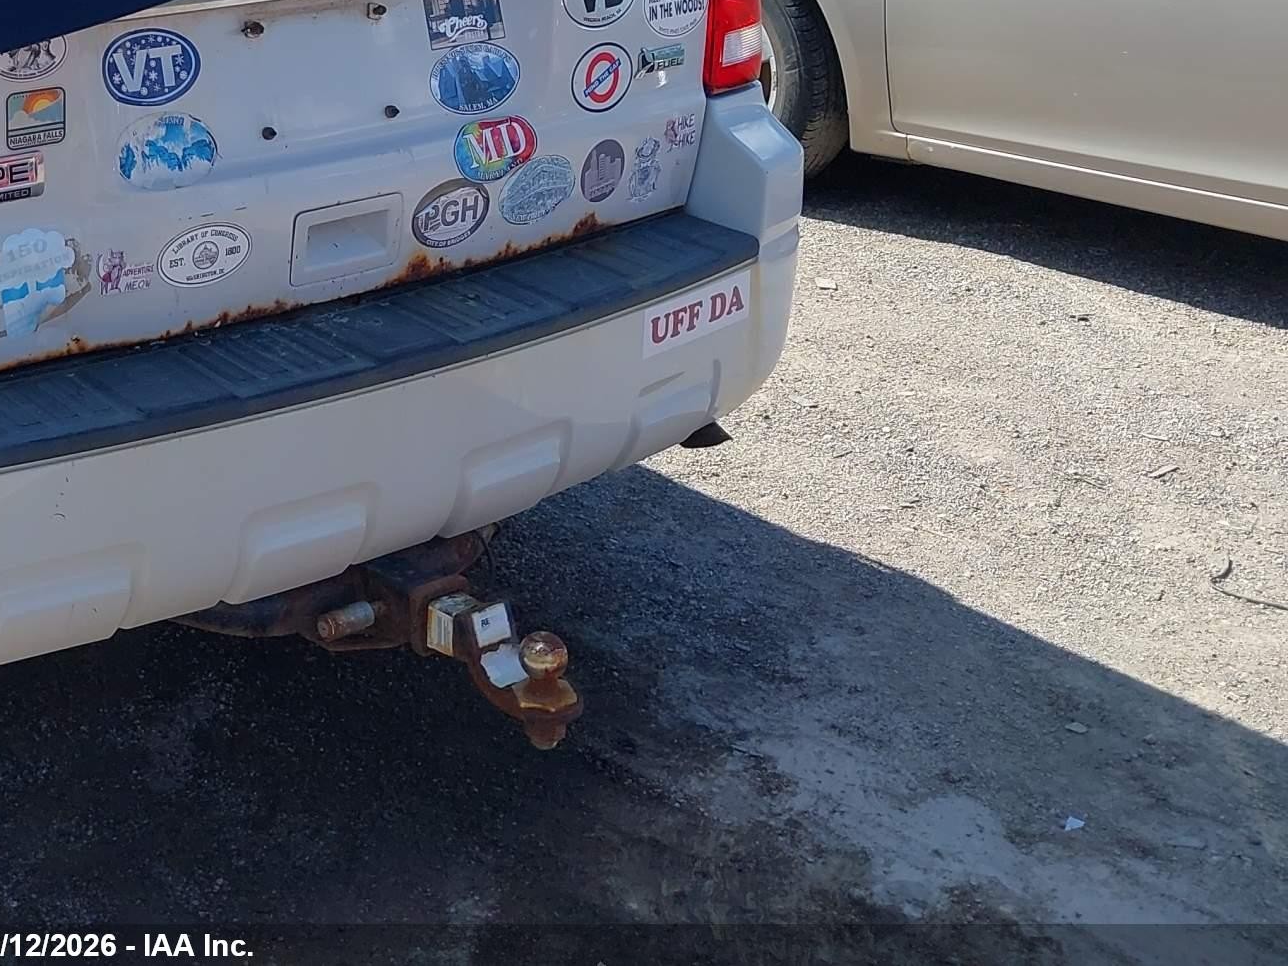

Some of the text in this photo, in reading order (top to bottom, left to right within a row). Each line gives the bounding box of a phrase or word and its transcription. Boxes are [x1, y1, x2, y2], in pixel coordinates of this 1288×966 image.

[649, 6, 658, 21] IN
[659, 2, 673, 18] THE
[438, 13, 488, 38] Cheers
[113, 44, 182, 93] VT
[9, 132, 41, 146] NIAGARA
[42, 130, 63, 140] FALLS
[463, 121, 527, 169] MD
[422, 194, 480, 232] PGH
[172, 231, 198, 255] LIBRARY
[169, 257, 186, 269] EST.
[124, 279, 152, 292] MEOW
[651, 285, 745, 343] UFF DA
